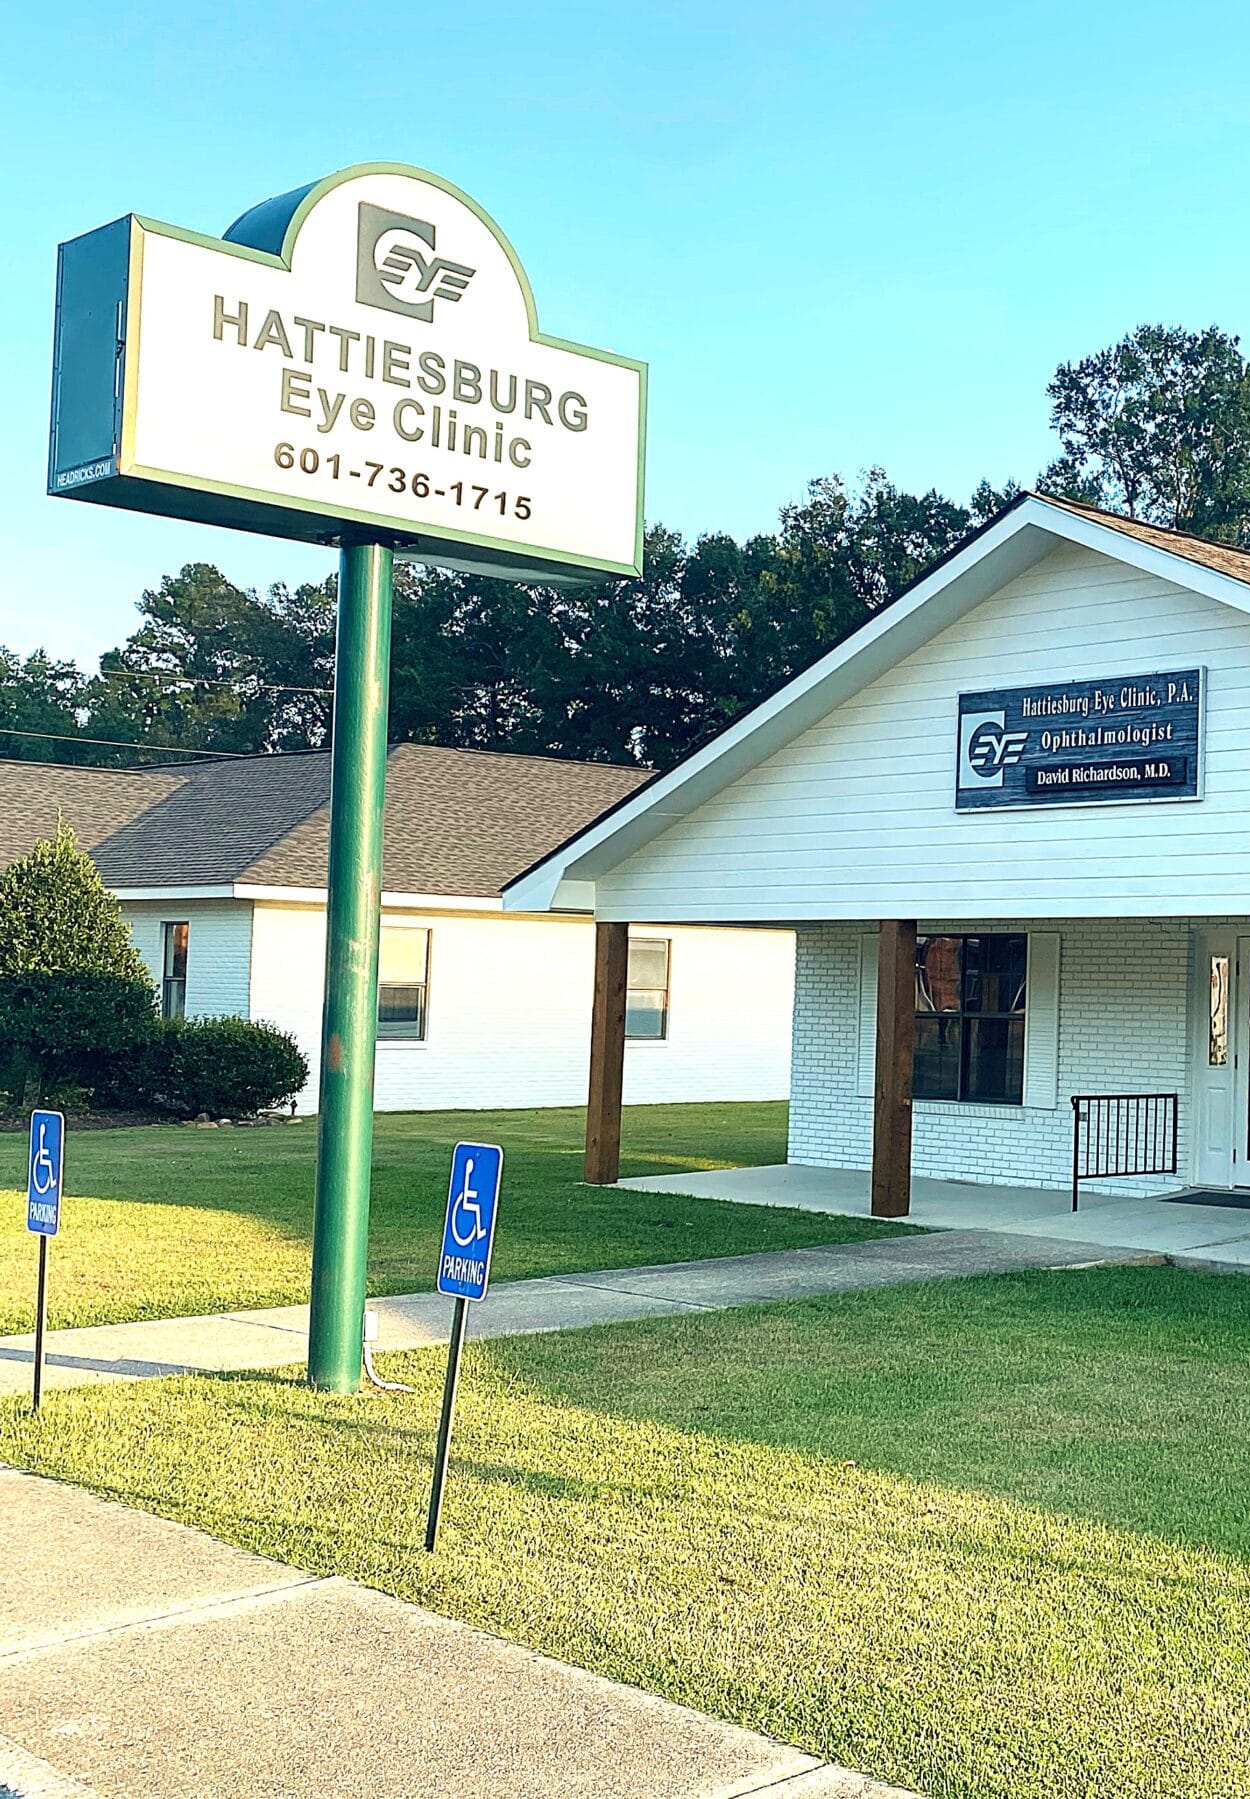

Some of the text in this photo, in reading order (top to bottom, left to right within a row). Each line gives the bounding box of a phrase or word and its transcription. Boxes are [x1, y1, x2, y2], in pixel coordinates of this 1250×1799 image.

[212, 294, 589, 433] HATTIESBURG
[280, 368, 533, 469] Eye Clinic
[57, 461, 111, 488] HEADRICKS.COM
[273, 441, 533, 522] 601-736-1715
[1022, 682, 1193, 718] Hattiesburg Eye Clinic, P.A.
[1041, 723, 1173, 752] Ophthalmologist
[1037, 763, 1171, 785] David Richardson, M.D.
[29, 1201, 57, 1225] PARKING
[442, 1254, 485, 1286] PARKING
